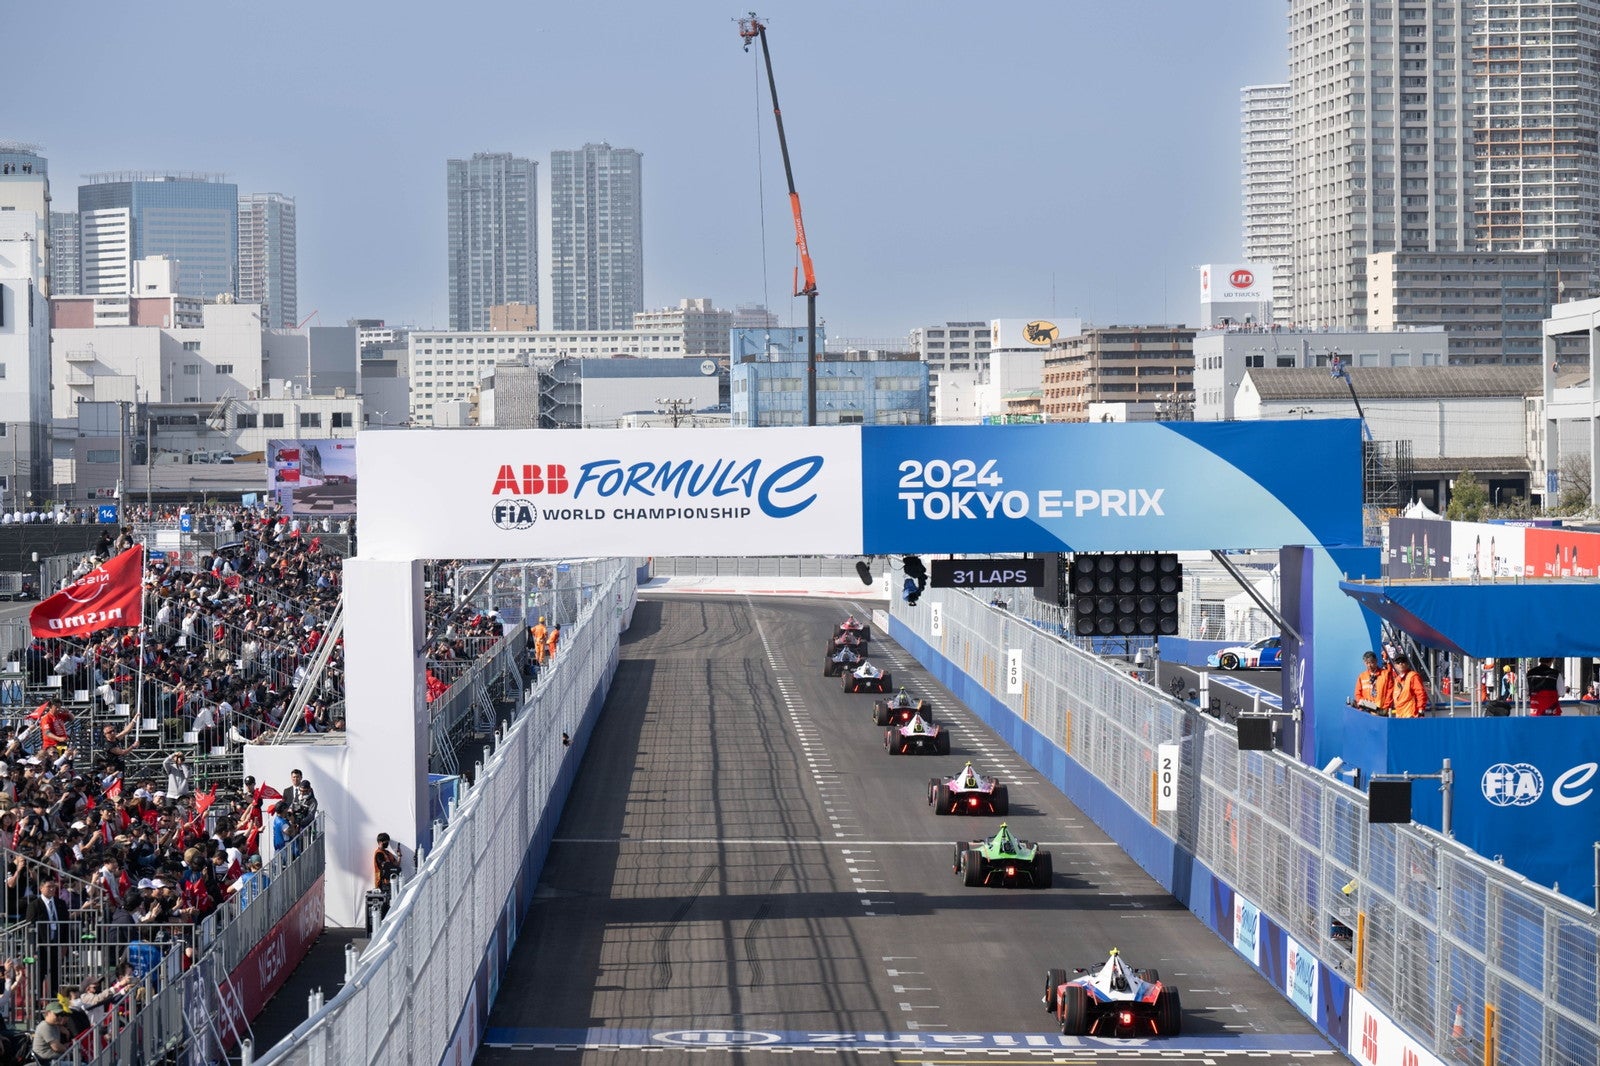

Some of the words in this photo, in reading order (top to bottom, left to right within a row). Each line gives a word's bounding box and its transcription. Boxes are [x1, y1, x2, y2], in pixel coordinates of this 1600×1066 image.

[1230, 273, 1254, 284] UD
[492, 464, 569, 496] ABB
[573, 458, 762, 499] FORMULA
[898, 459, 1003, 488] 2024
[101, 509, 114, 519] 14
[542, 508, 606, 521] WORLD
[613, 506, 751, 521] CHAMPIONSHIP
[898, 491, 1030, 520] TOKYO
[1038, 488, 1165, 518] E-PRIX
[181, 518, 190, 528] 13
[953, 570, 975, 584] 31
[979, 570, 1027, 583] LAPS
[1163, 757, 1172, 798] 200
[258, 931, 287, 991] NISSAN
[808, 1033, 1150, 1047] Allianz
[1362, 1011, 1378, 1066] ABB
